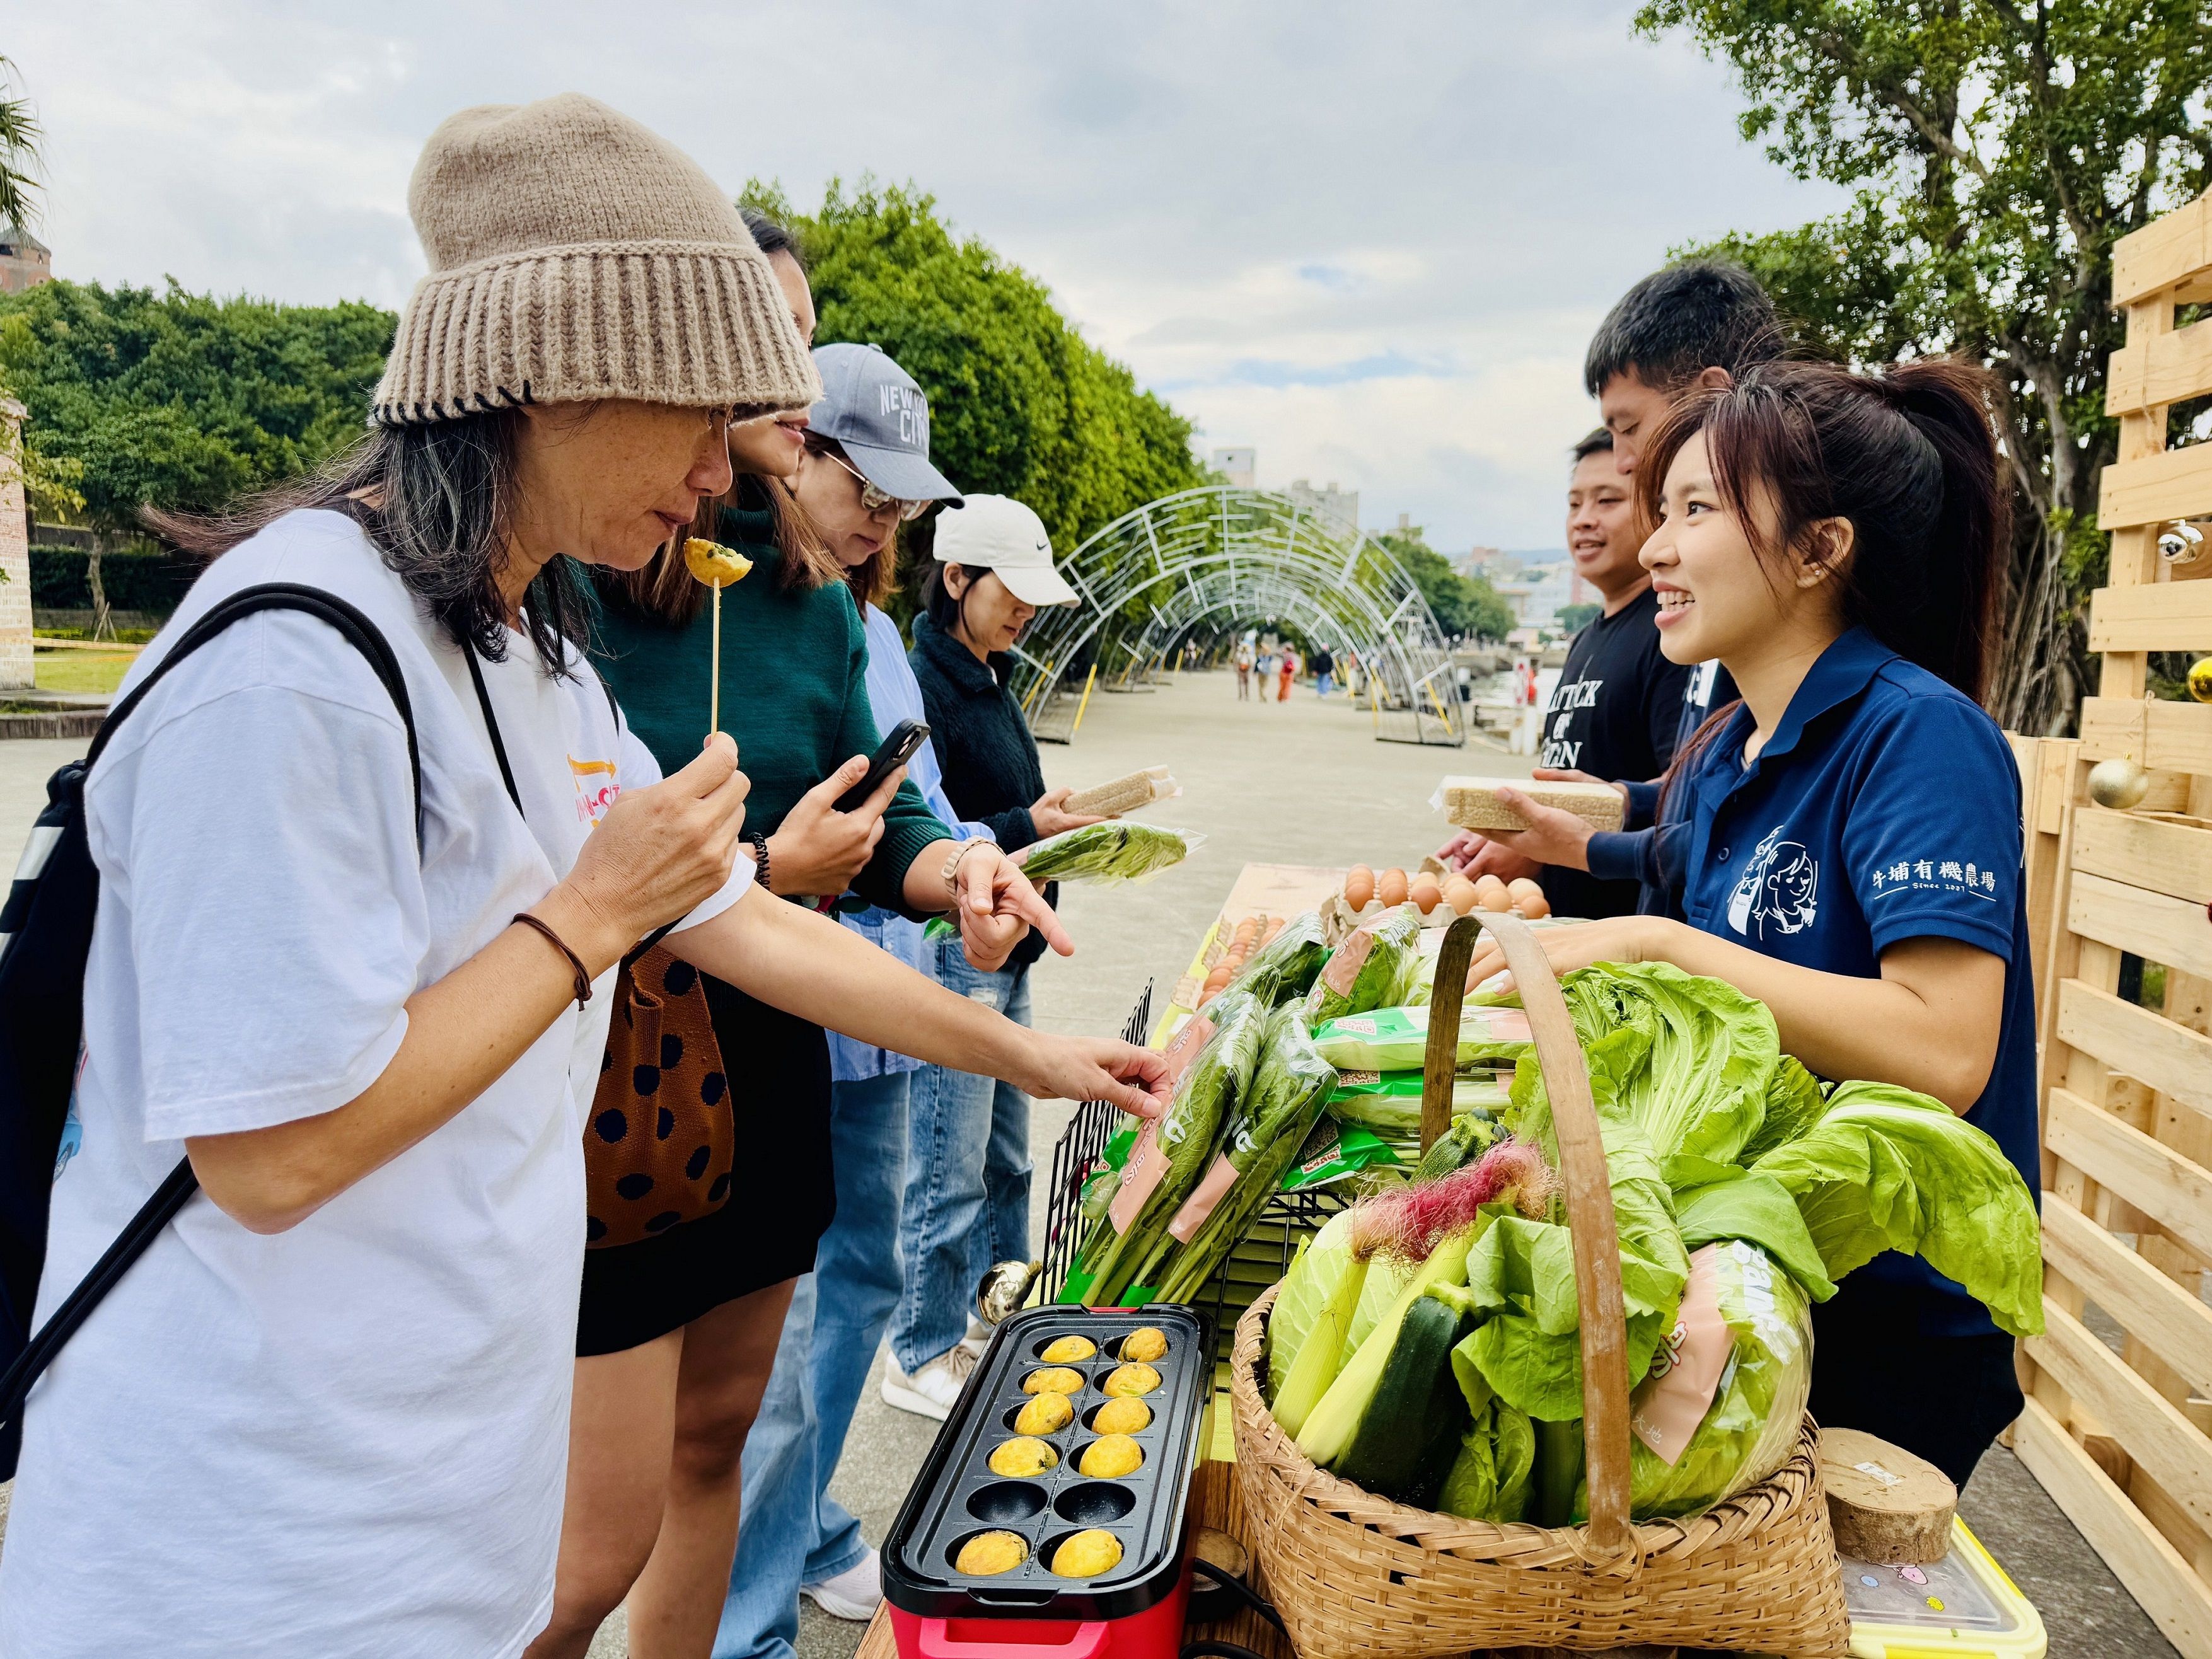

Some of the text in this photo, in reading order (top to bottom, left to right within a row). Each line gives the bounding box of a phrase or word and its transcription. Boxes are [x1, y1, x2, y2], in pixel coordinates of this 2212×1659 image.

[880, 384, 913, 416] NEW
[1873, 858, 1996, 893] 牛埔有機農場
